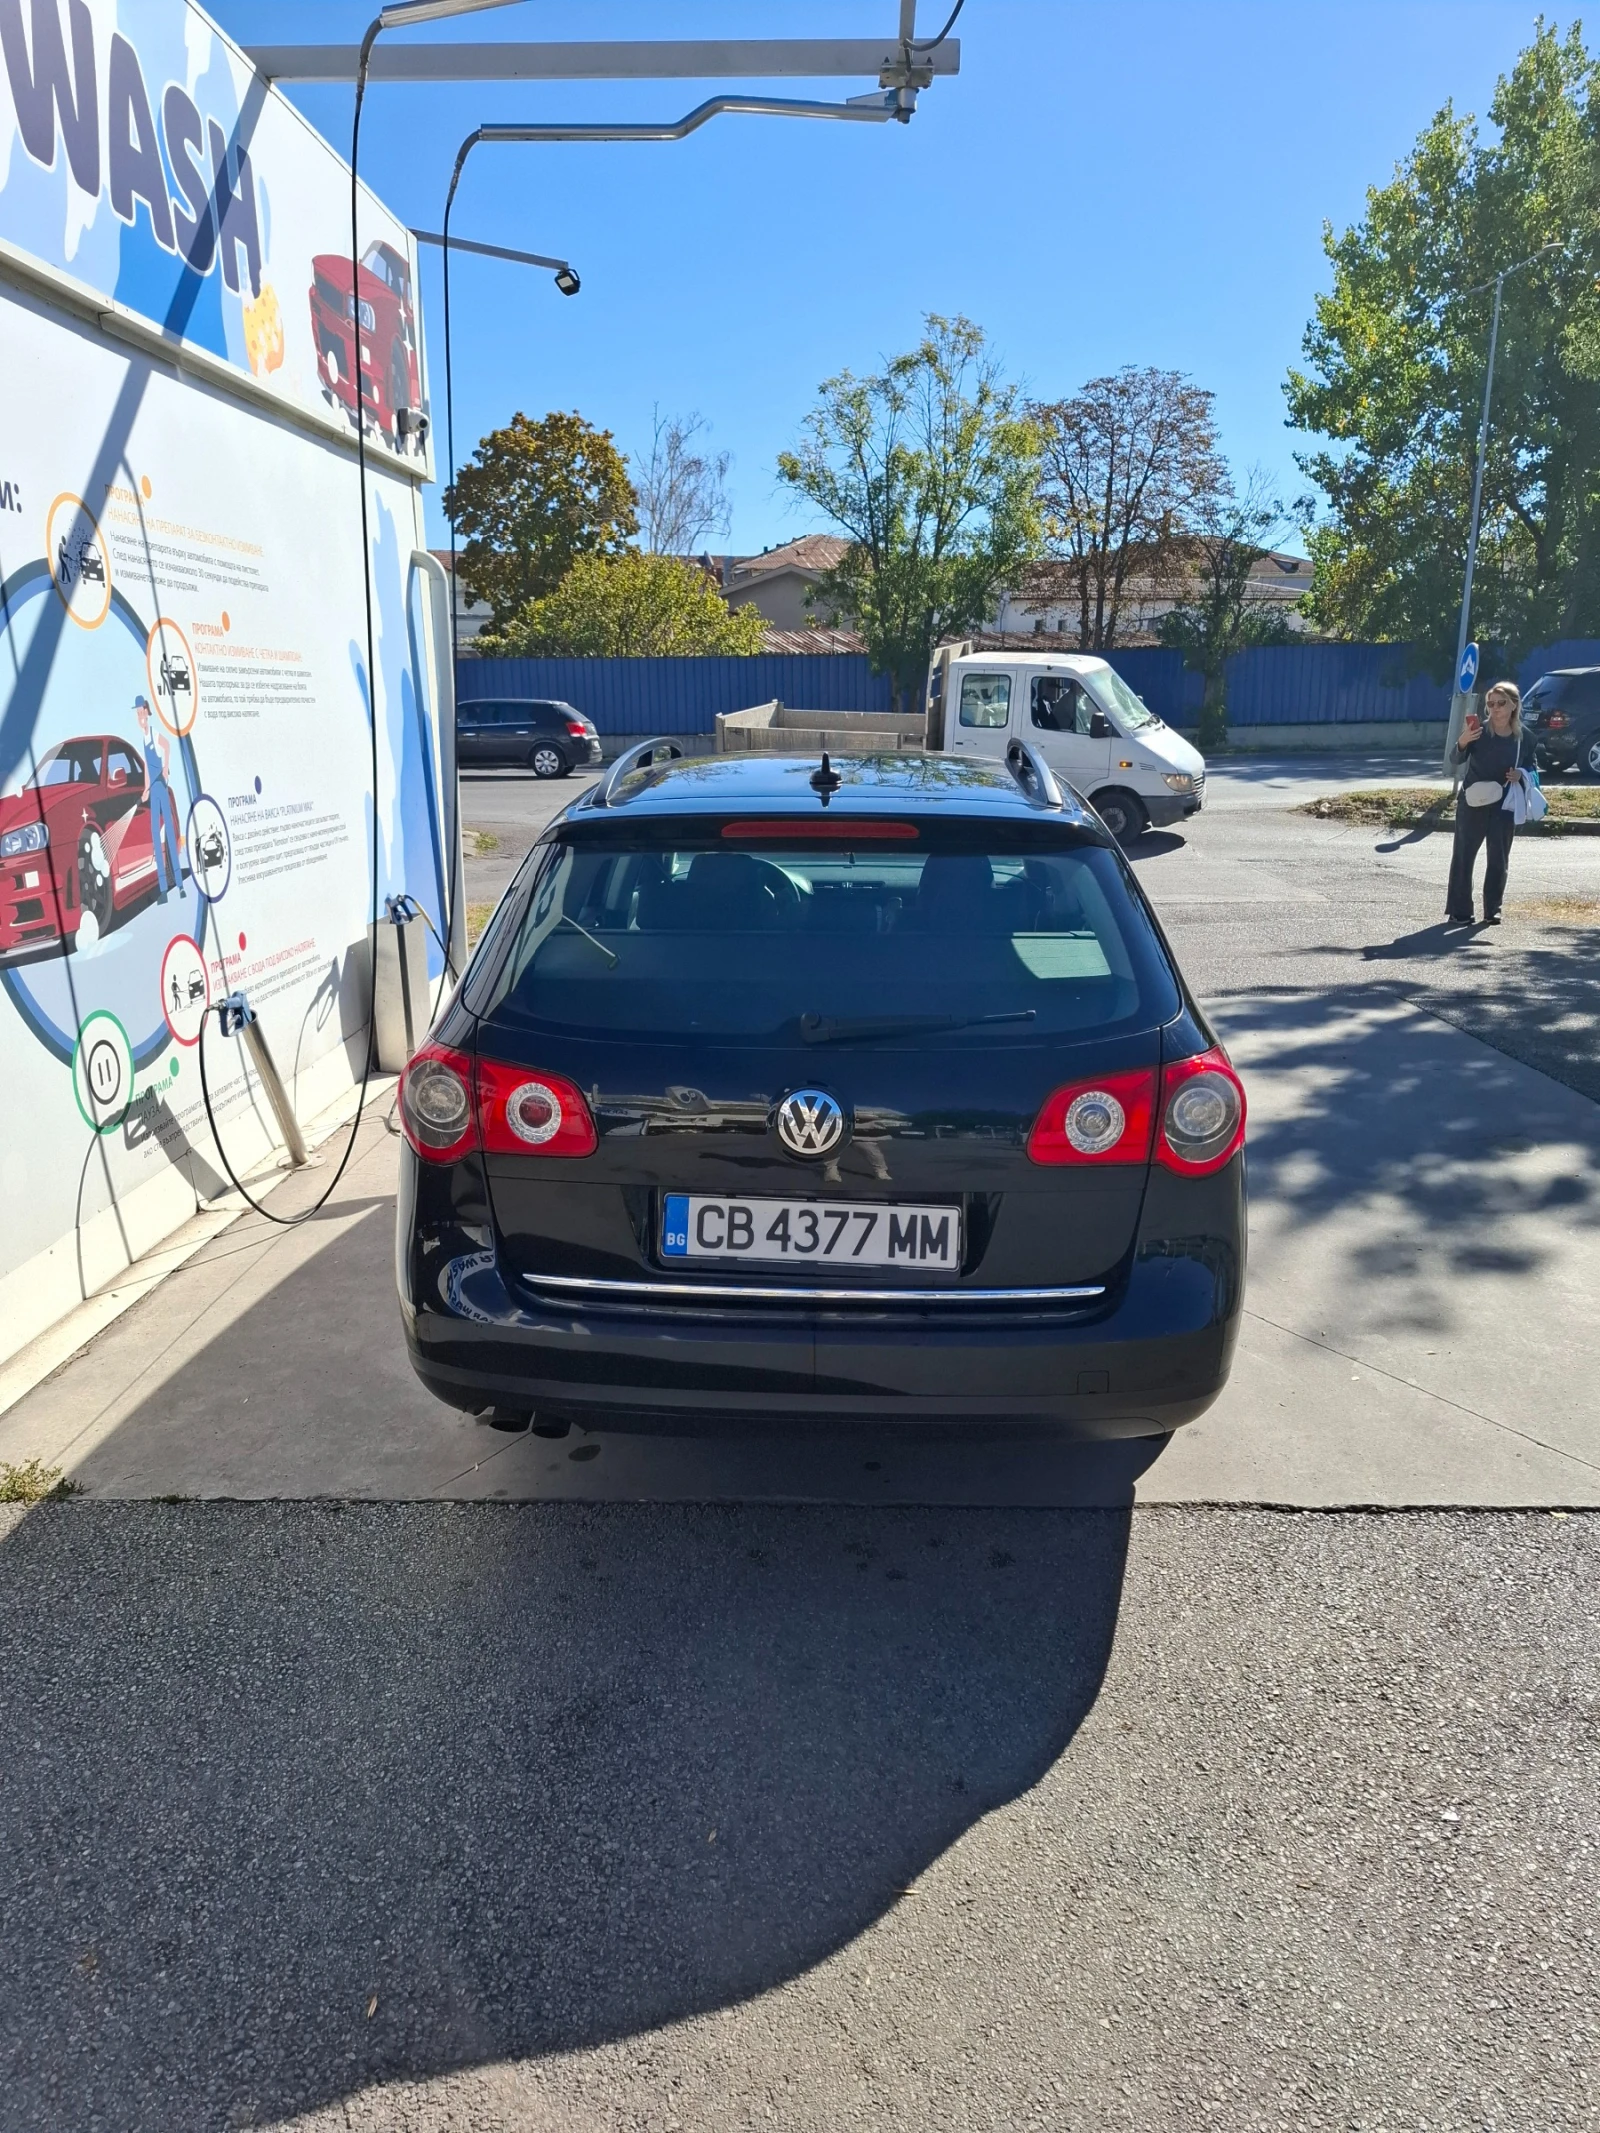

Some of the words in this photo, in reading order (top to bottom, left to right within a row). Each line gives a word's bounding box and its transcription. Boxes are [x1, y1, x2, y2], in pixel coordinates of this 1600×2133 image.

[0, 0, 263, 300] WASH
[104, 483, 145, 507] ПРОГРАМА
[108, 508, 143, 528] НАНАСЯН
[112, 548, 127, 561] След
[191, 622, 224, 637] ПРОГРАМА
[228, 794, 257, 808] ПРОГРАМА
[211, 953, 241, 974] ПРОГРАМА
[212, 968, 247, 993] ИЗПАКВАНЕ
[252, 960, 265, 976] ВОДА
[135, 1076, 174, 1107] ПРОГРАМА
[667, 1233, 685, 1246] BG
[696, 1204, 755, 1250] CB
[765, 1208, 878, 1256] 4377
[888, 1213, 949, 1261] MM
